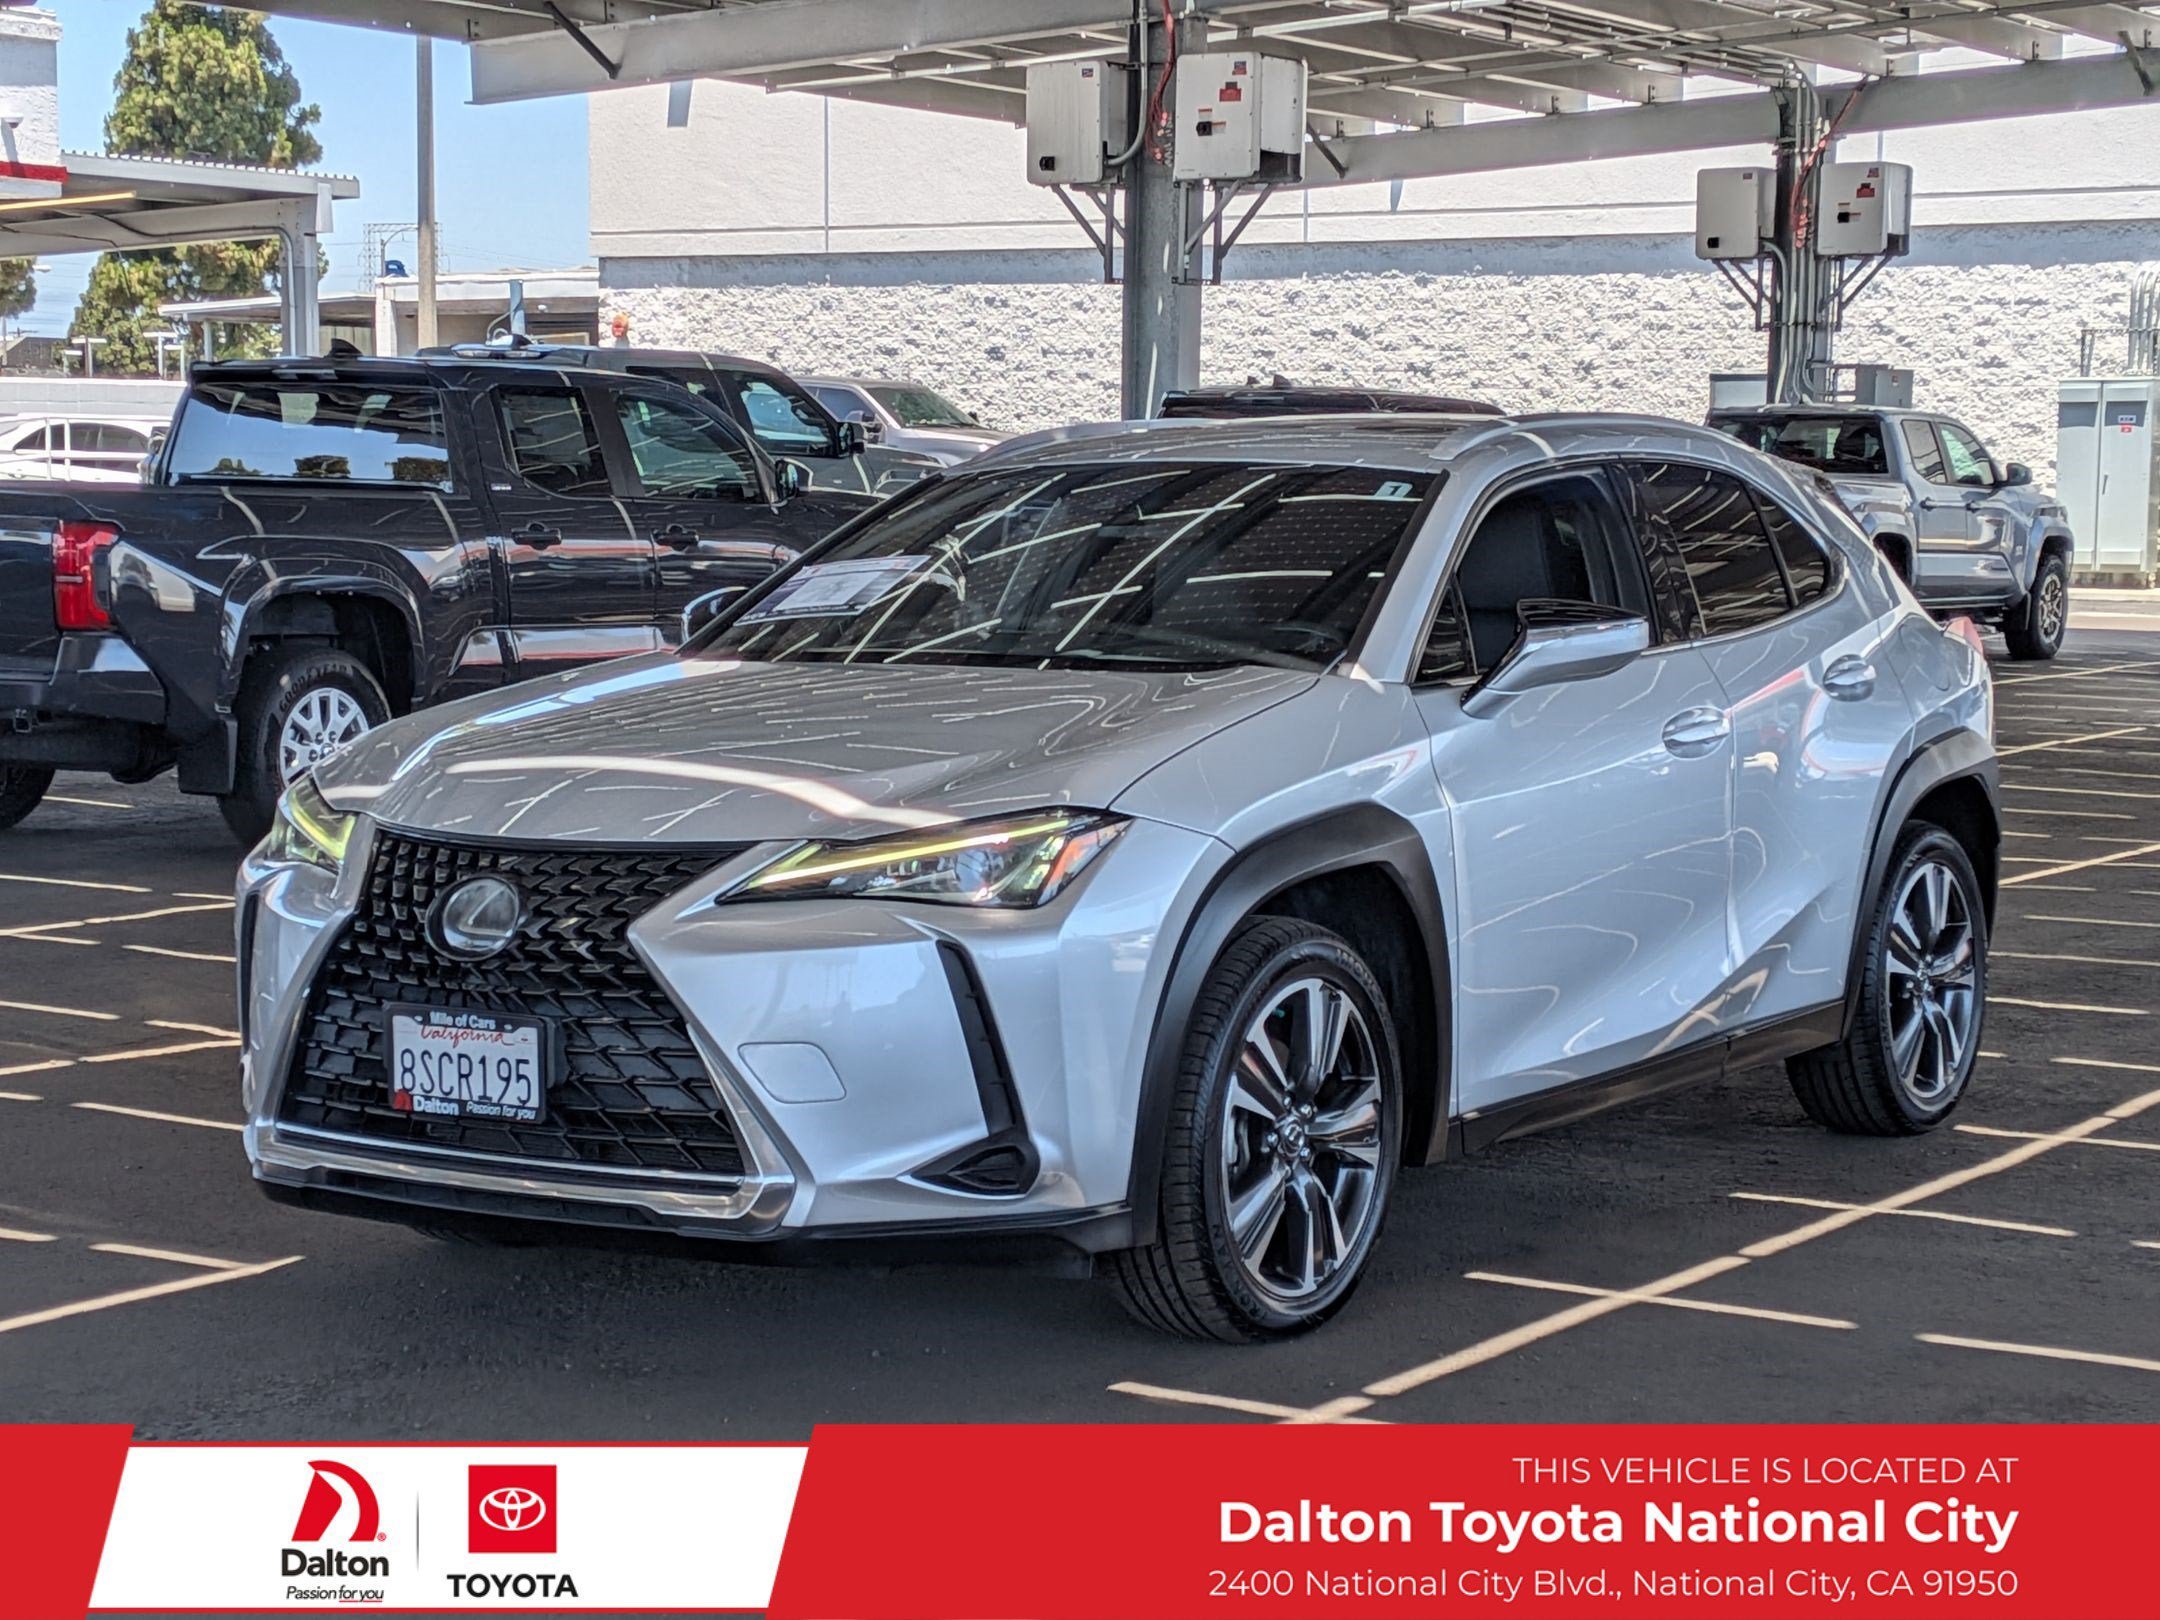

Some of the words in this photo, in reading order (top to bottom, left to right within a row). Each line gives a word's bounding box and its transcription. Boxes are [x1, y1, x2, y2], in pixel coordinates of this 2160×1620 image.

[429, 1011, 453, 1026] Mile
[455, 1014, 468, 1027] of
[469, 1015, 496, 1030] Cars
[400, 1048, 531, 1107] 8SCR195
[413, 1095, 460, 1116] Dalton
[466, 1101, 500, 1116] Passion
[502, 1104, 517, 1117] for
[518, 1108, 536, 1121] you
